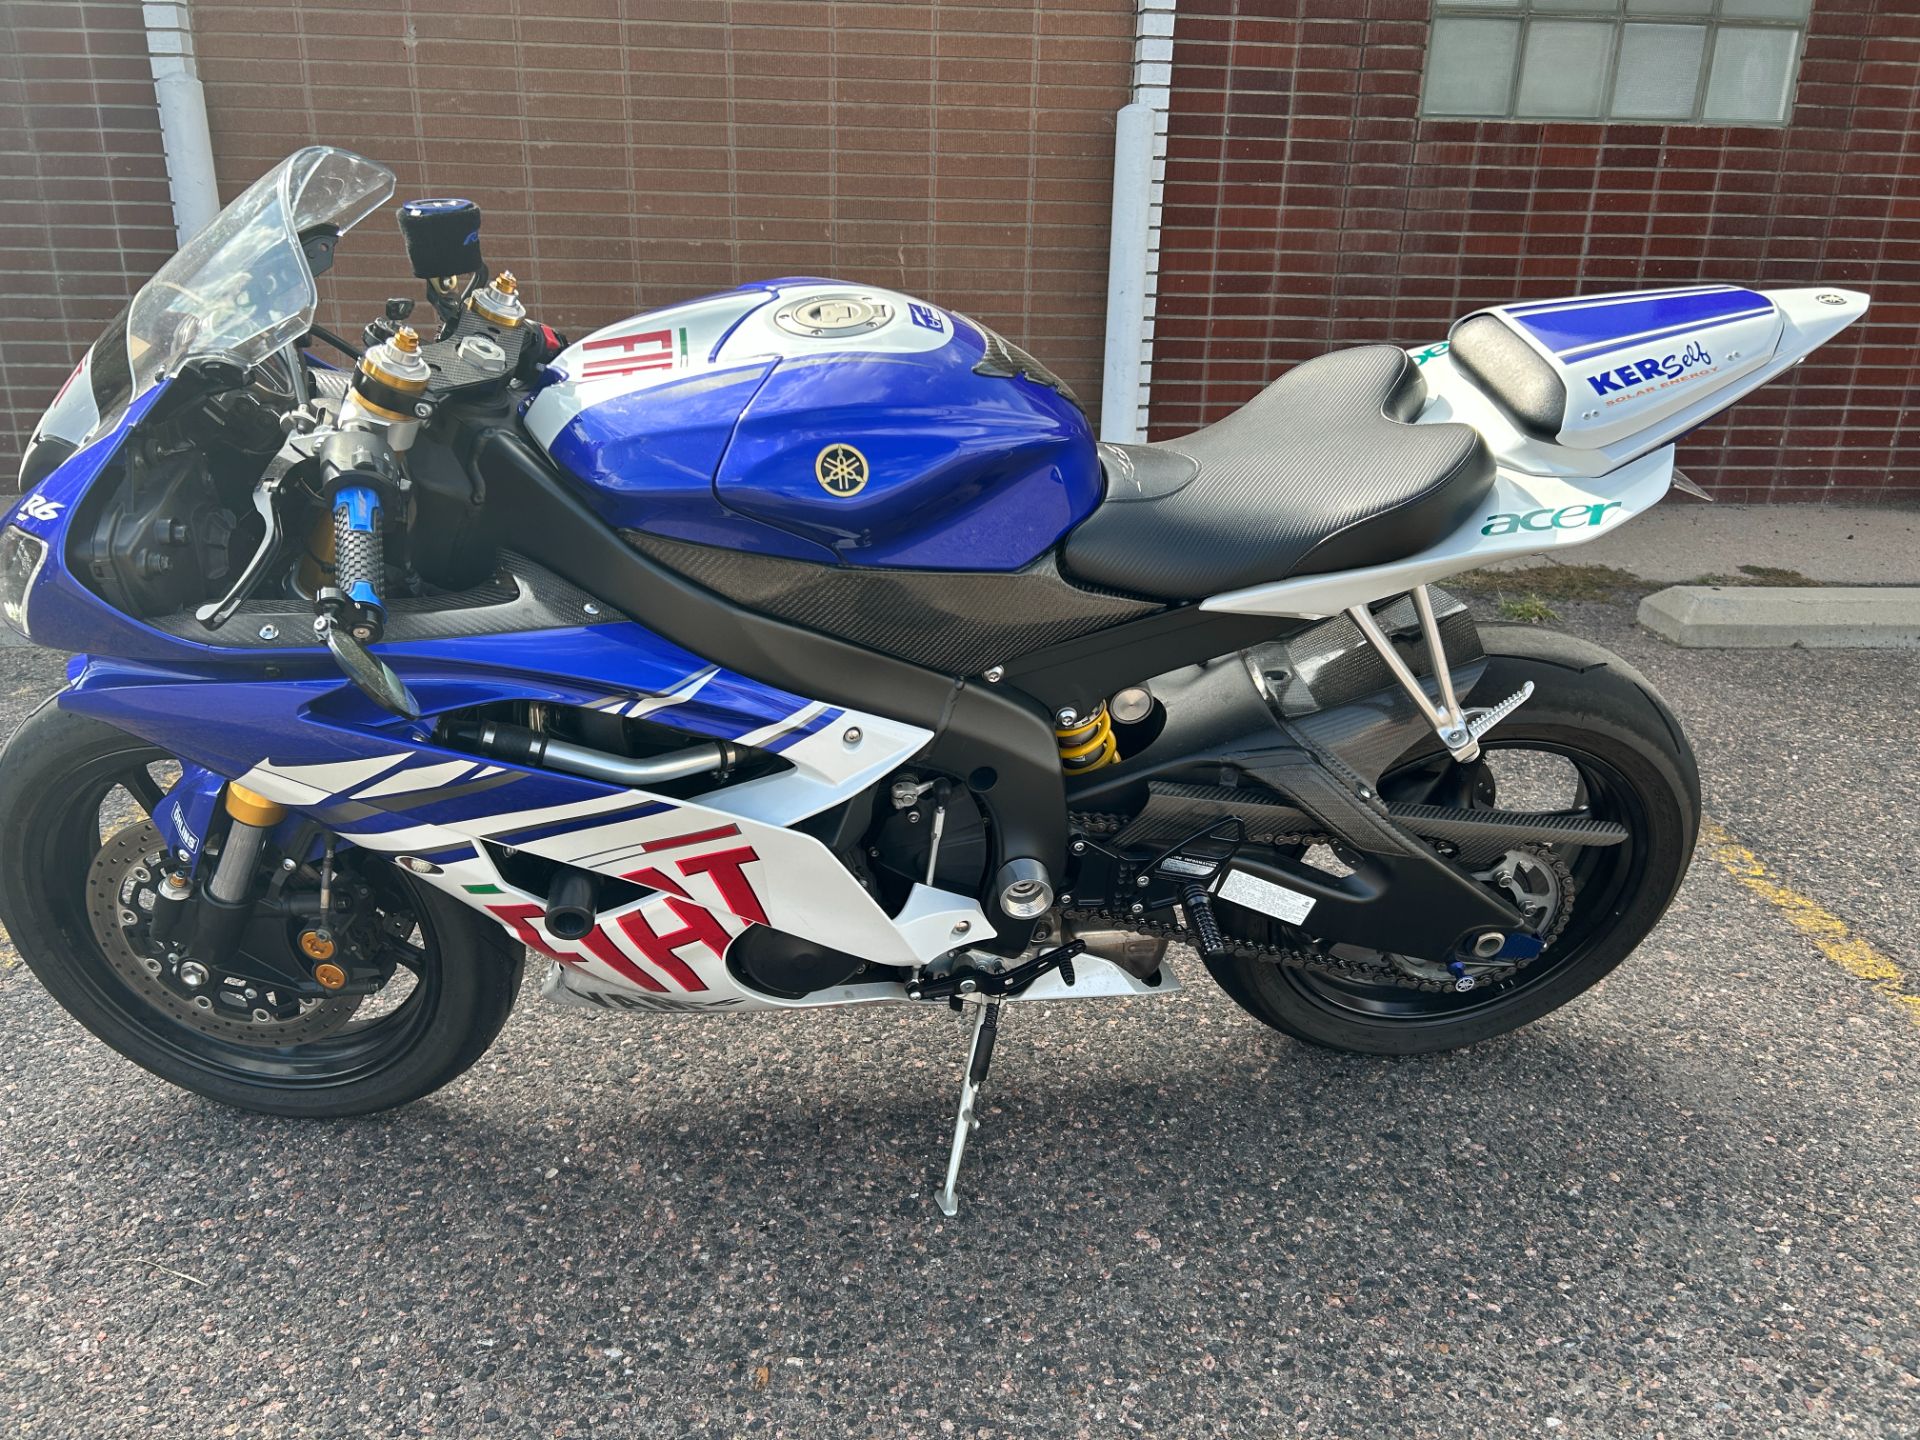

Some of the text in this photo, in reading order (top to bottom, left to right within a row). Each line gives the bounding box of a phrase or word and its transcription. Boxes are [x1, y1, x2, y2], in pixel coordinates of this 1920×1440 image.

[1605, 366, 1719, 408] SOLAR ENERGY
[20, 493, 66, 521] R6
[1480, 501, 1622, 536] acer
